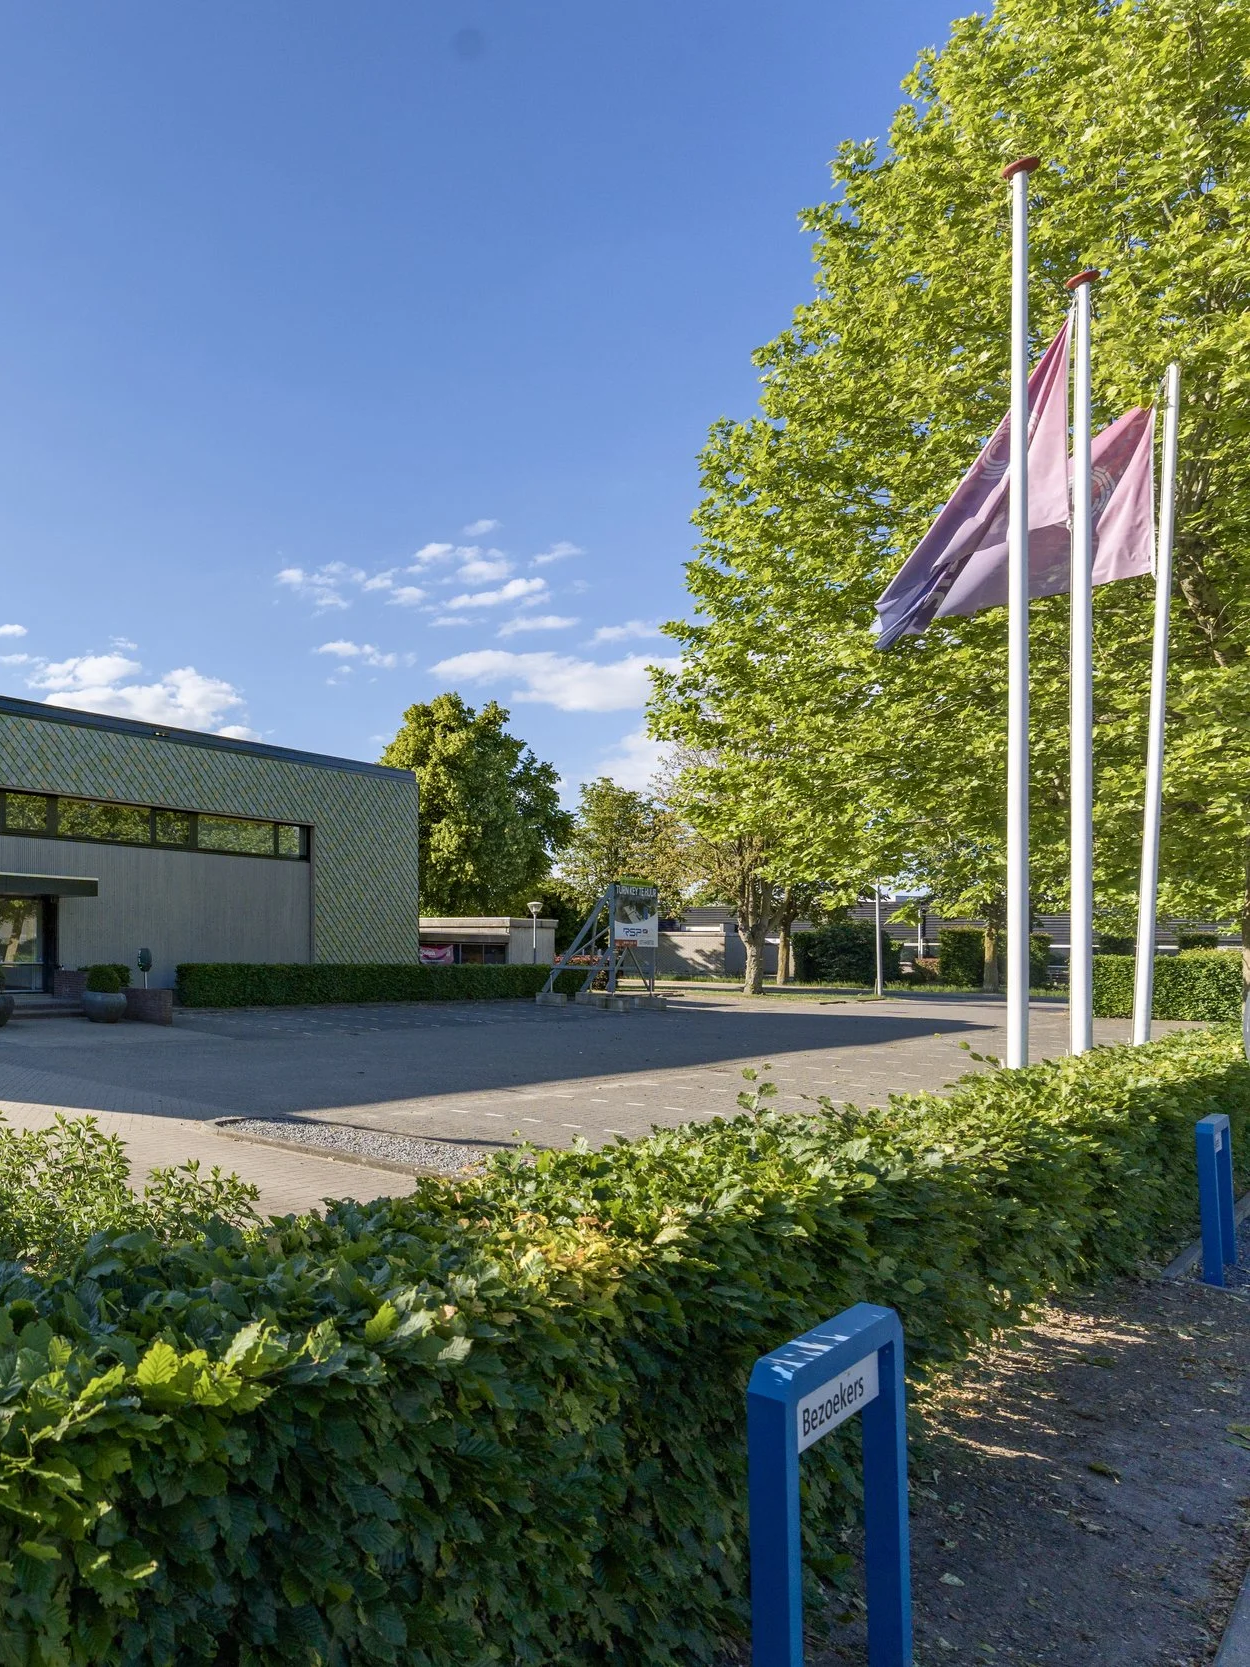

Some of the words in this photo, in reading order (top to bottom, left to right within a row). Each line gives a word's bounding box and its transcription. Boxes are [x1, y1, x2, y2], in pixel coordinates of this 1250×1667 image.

[615, 885, 629, 895] TURN
[630, 886, 638, 896] KEY
[639, 887, 644, 897] TE
[623, 928, 642, 937] RSP
[802, 1376, 864, 1437] Bezoekers
